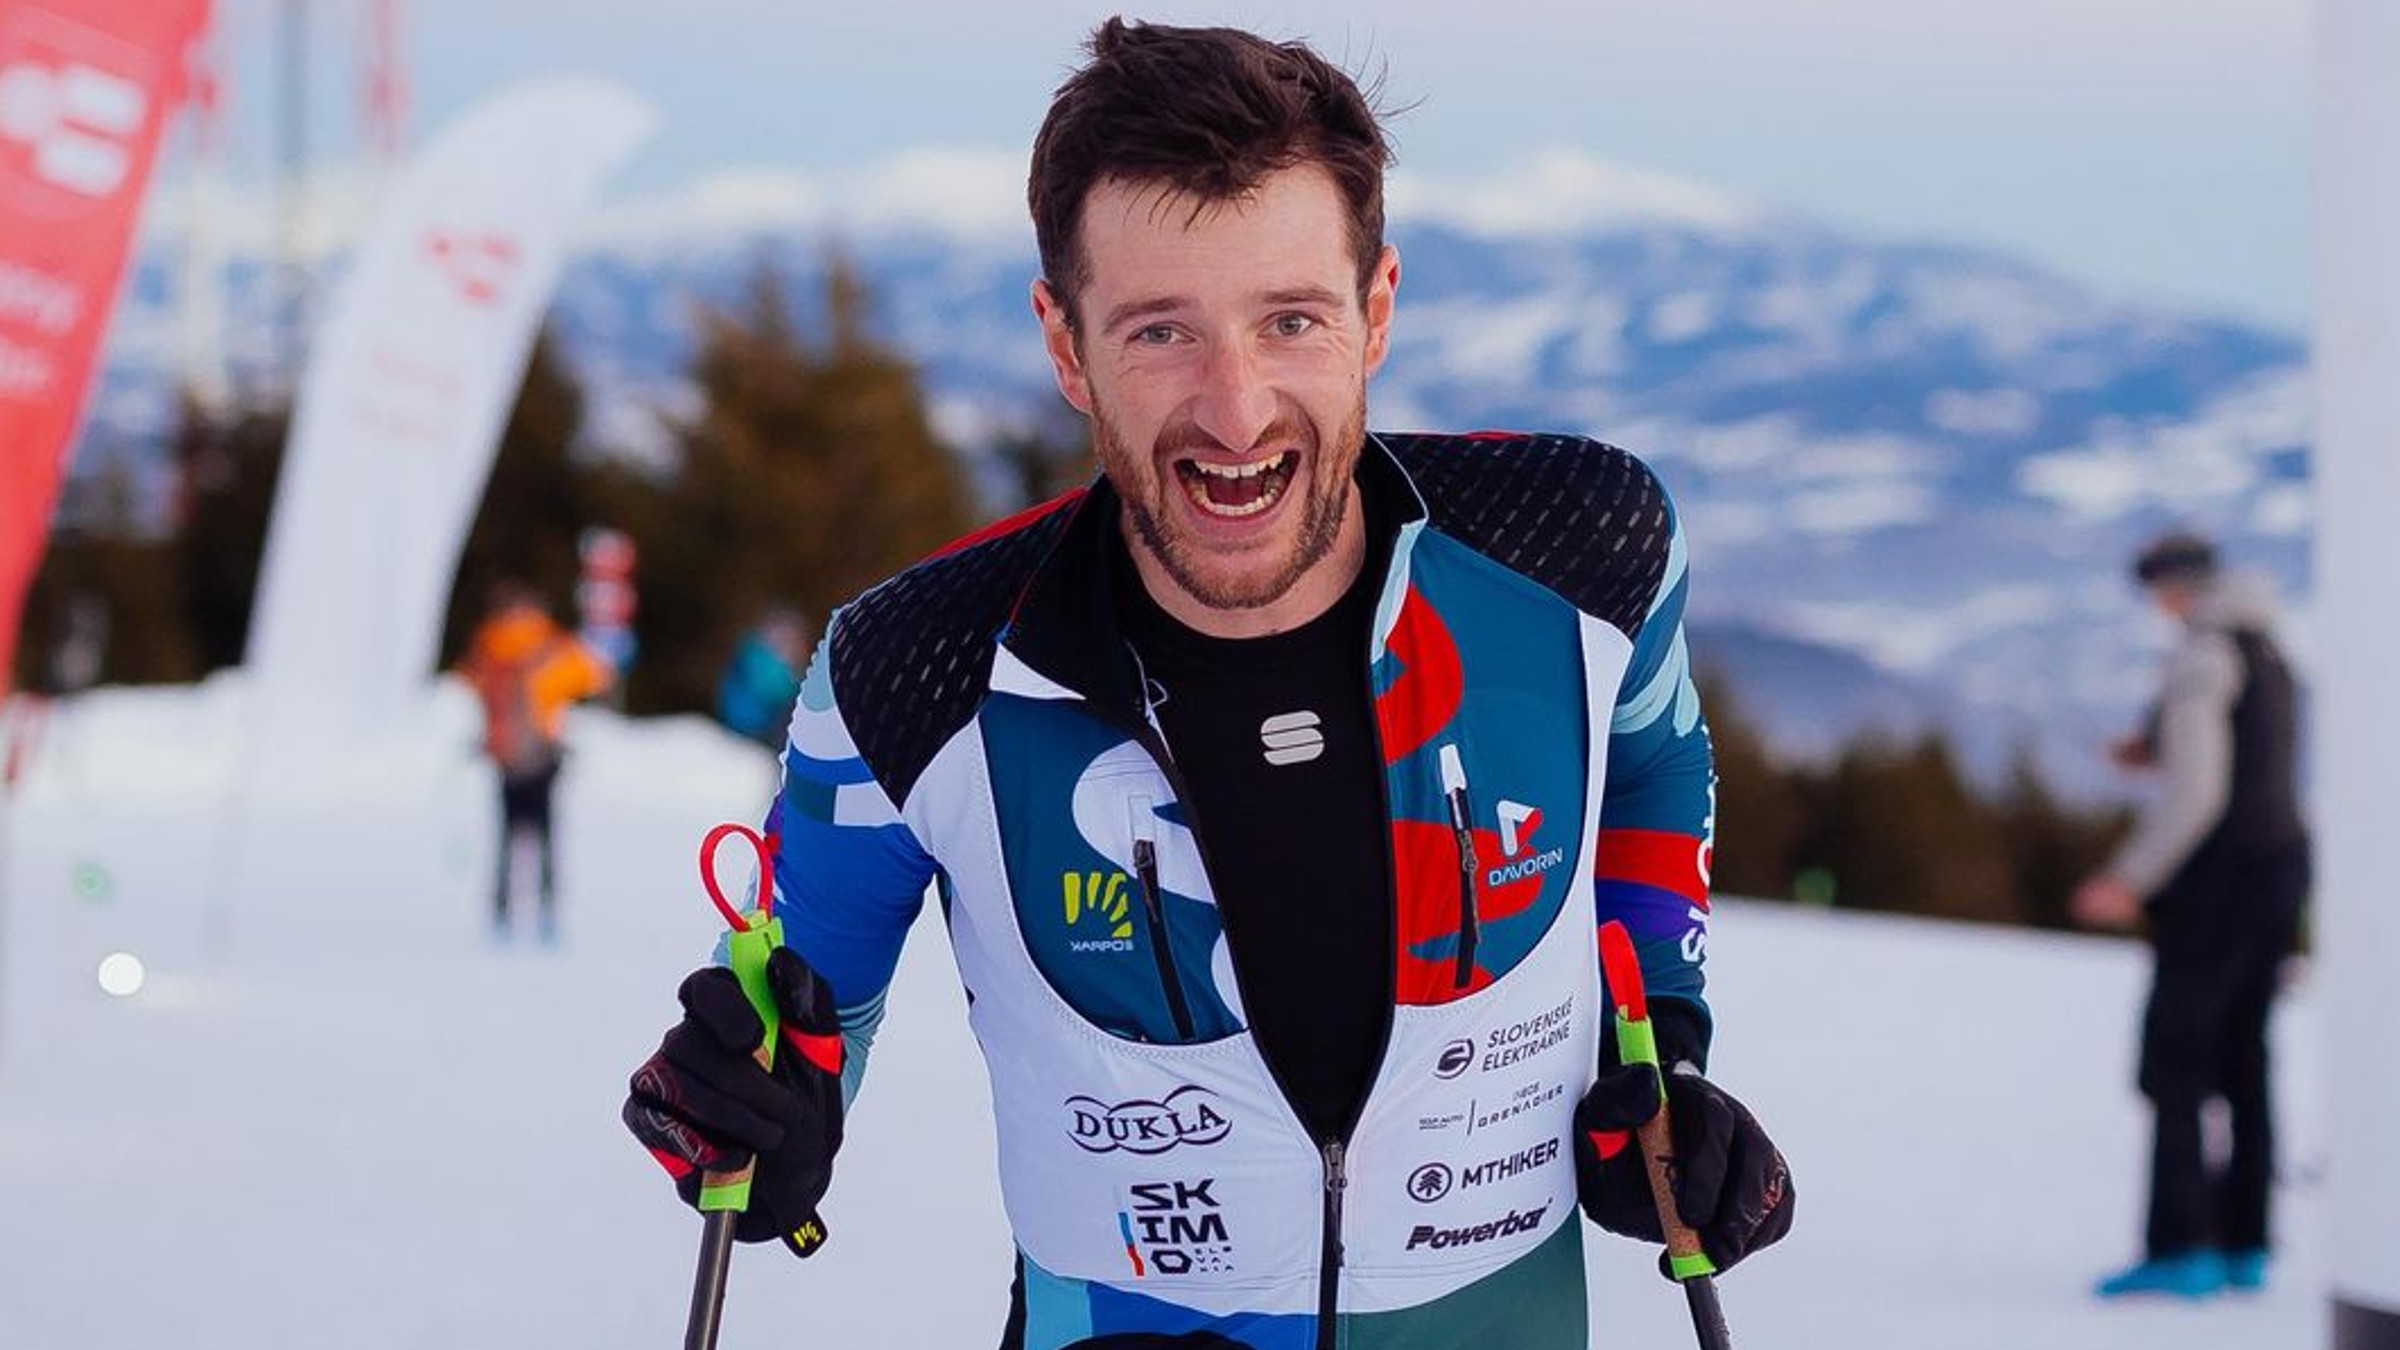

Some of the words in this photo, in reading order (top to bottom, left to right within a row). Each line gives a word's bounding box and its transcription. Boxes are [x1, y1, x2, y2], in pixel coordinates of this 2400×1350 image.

[1489, 848, 1563, 886] DAVORIN
[1073, 1103, 1226, 1140] DUKLA
[1461, 1137, 1559, 1189] MTHIKER
[1406, 1202, 1549, 1250] Powerbar
